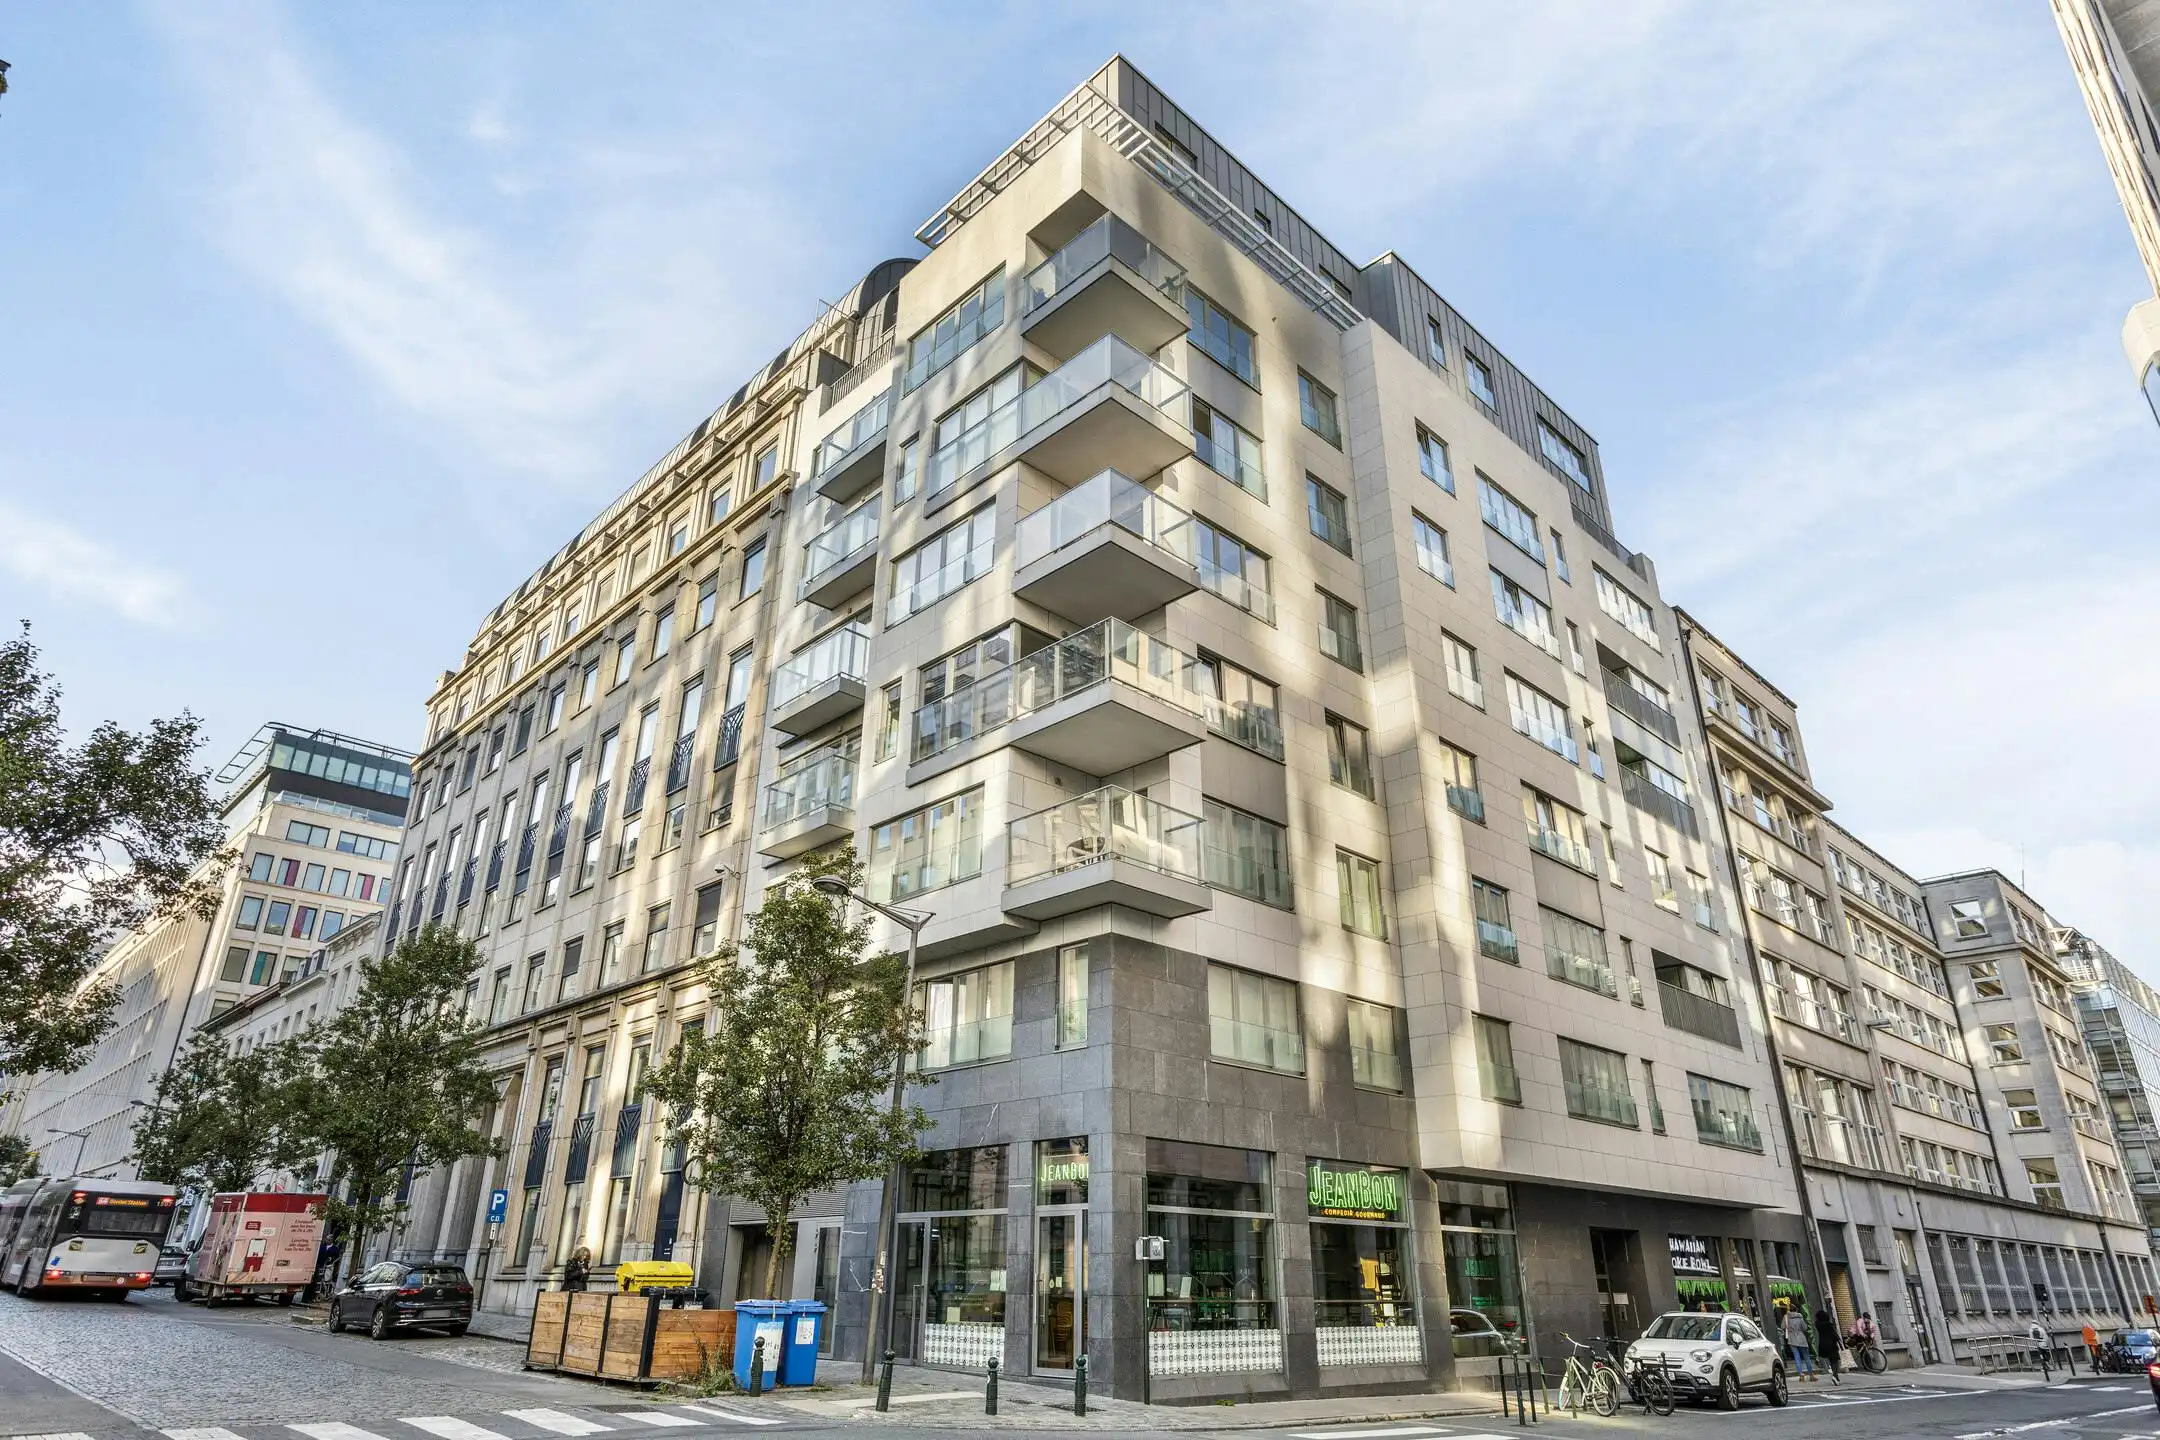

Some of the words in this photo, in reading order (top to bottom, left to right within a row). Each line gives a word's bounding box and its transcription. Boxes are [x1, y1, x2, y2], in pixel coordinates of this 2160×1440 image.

[1310, 1166, 1397, 1210] JEANBON
[491, 1193, 505, 1210] P
[1668, 1238, 1706, 1254] HAWAIIAN
[1690, 1256, 1714, 1271] BOWL
